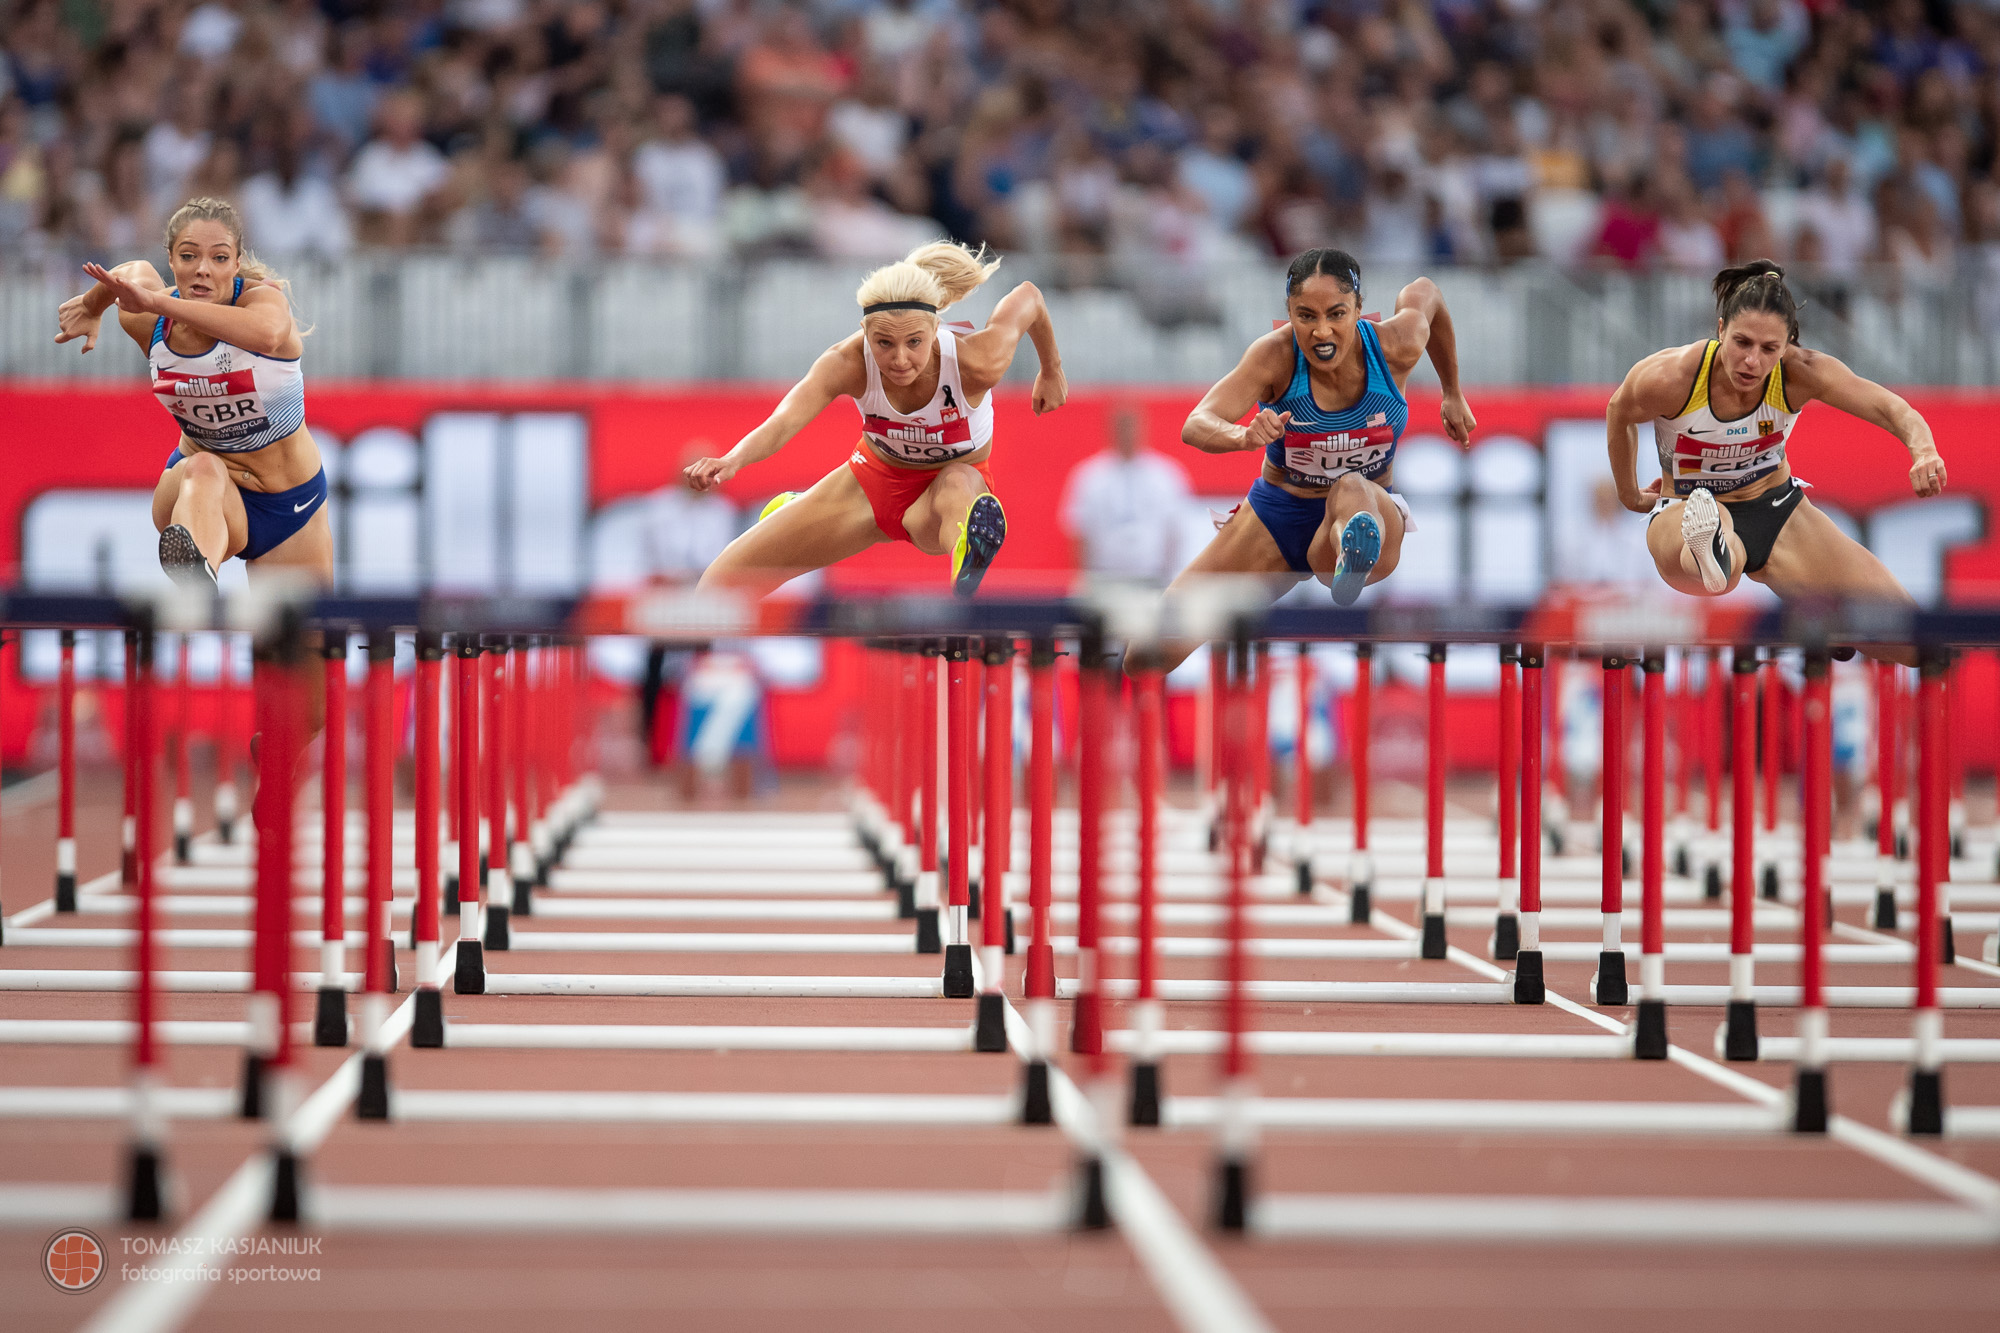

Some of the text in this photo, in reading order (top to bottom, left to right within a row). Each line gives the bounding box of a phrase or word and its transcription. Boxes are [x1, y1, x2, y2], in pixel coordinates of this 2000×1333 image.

[174, 377, 229, 397] müller
[192, 399, 259, 423] GBR
[186, 419, 264, 435] ATHLETICS WORLD CUP
[886, 426, 945, 444] müller
[1726, 427, 1748, 436] DKB
[1310, 432, 1369, 452] müller
[1700, 443, 1760, 459] müller
[1320, 449, 1382, 471] USA
[1369, 461, 1382, 472] CUP
